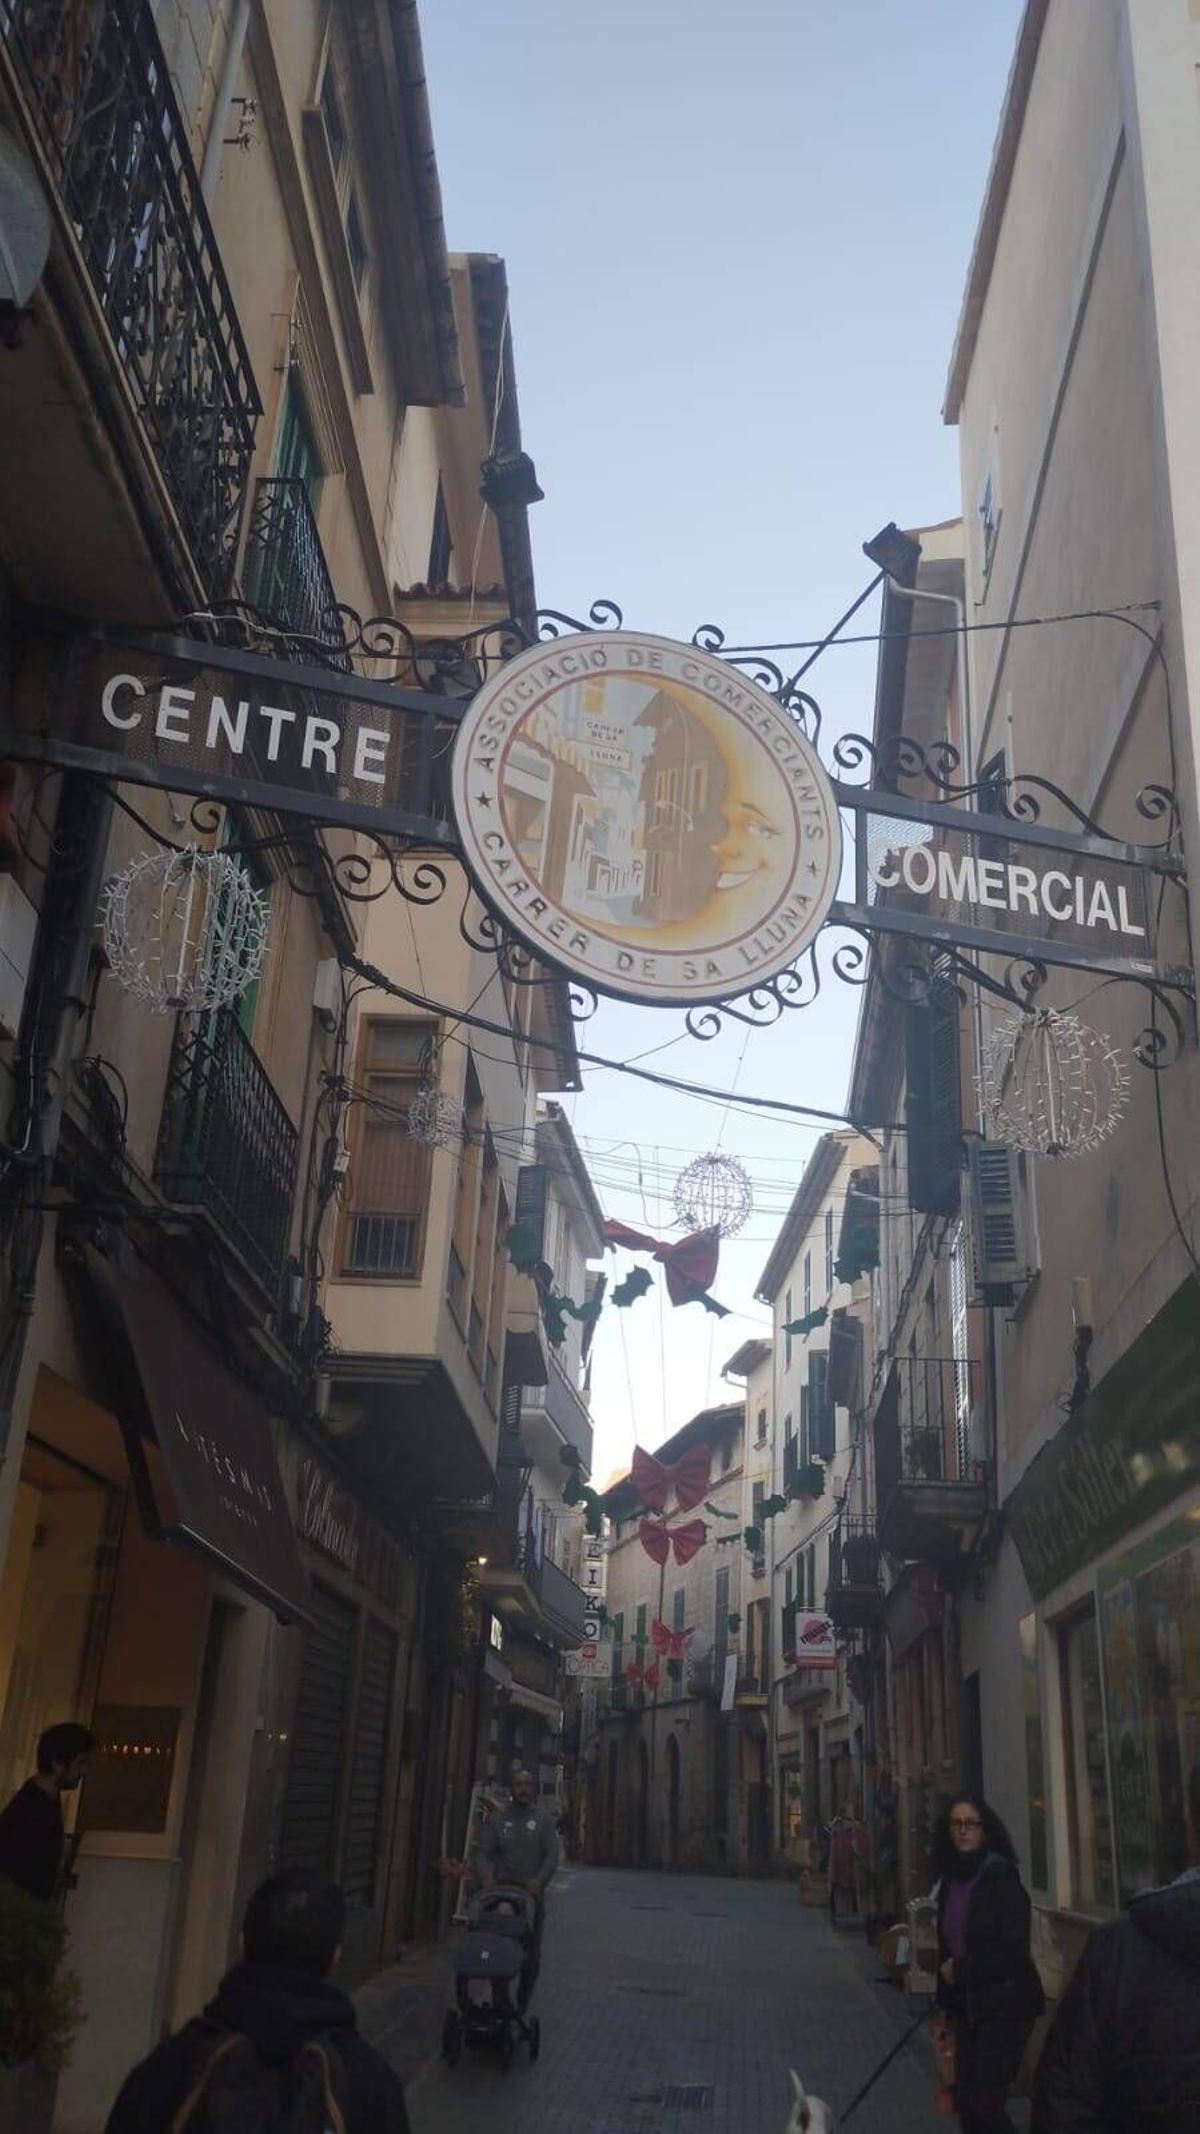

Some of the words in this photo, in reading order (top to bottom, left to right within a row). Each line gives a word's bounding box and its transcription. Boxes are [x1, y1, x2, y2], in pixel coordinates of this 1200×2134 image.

[101, 673, 391, 785] CENTRE
[626, 648, 664, 671] DE
[681, 662, 825, 841] COMERCIANTS
[483, 832, 590, 954] CARRER
[615, 951, 657, 978] DE
[682, 954, 724, 981] SA
[738, 893, 813, 967] LLUNA
[872, 840, 1146, 937] COMERCIAL
[584, 1541, 601, 1636] EIKO
